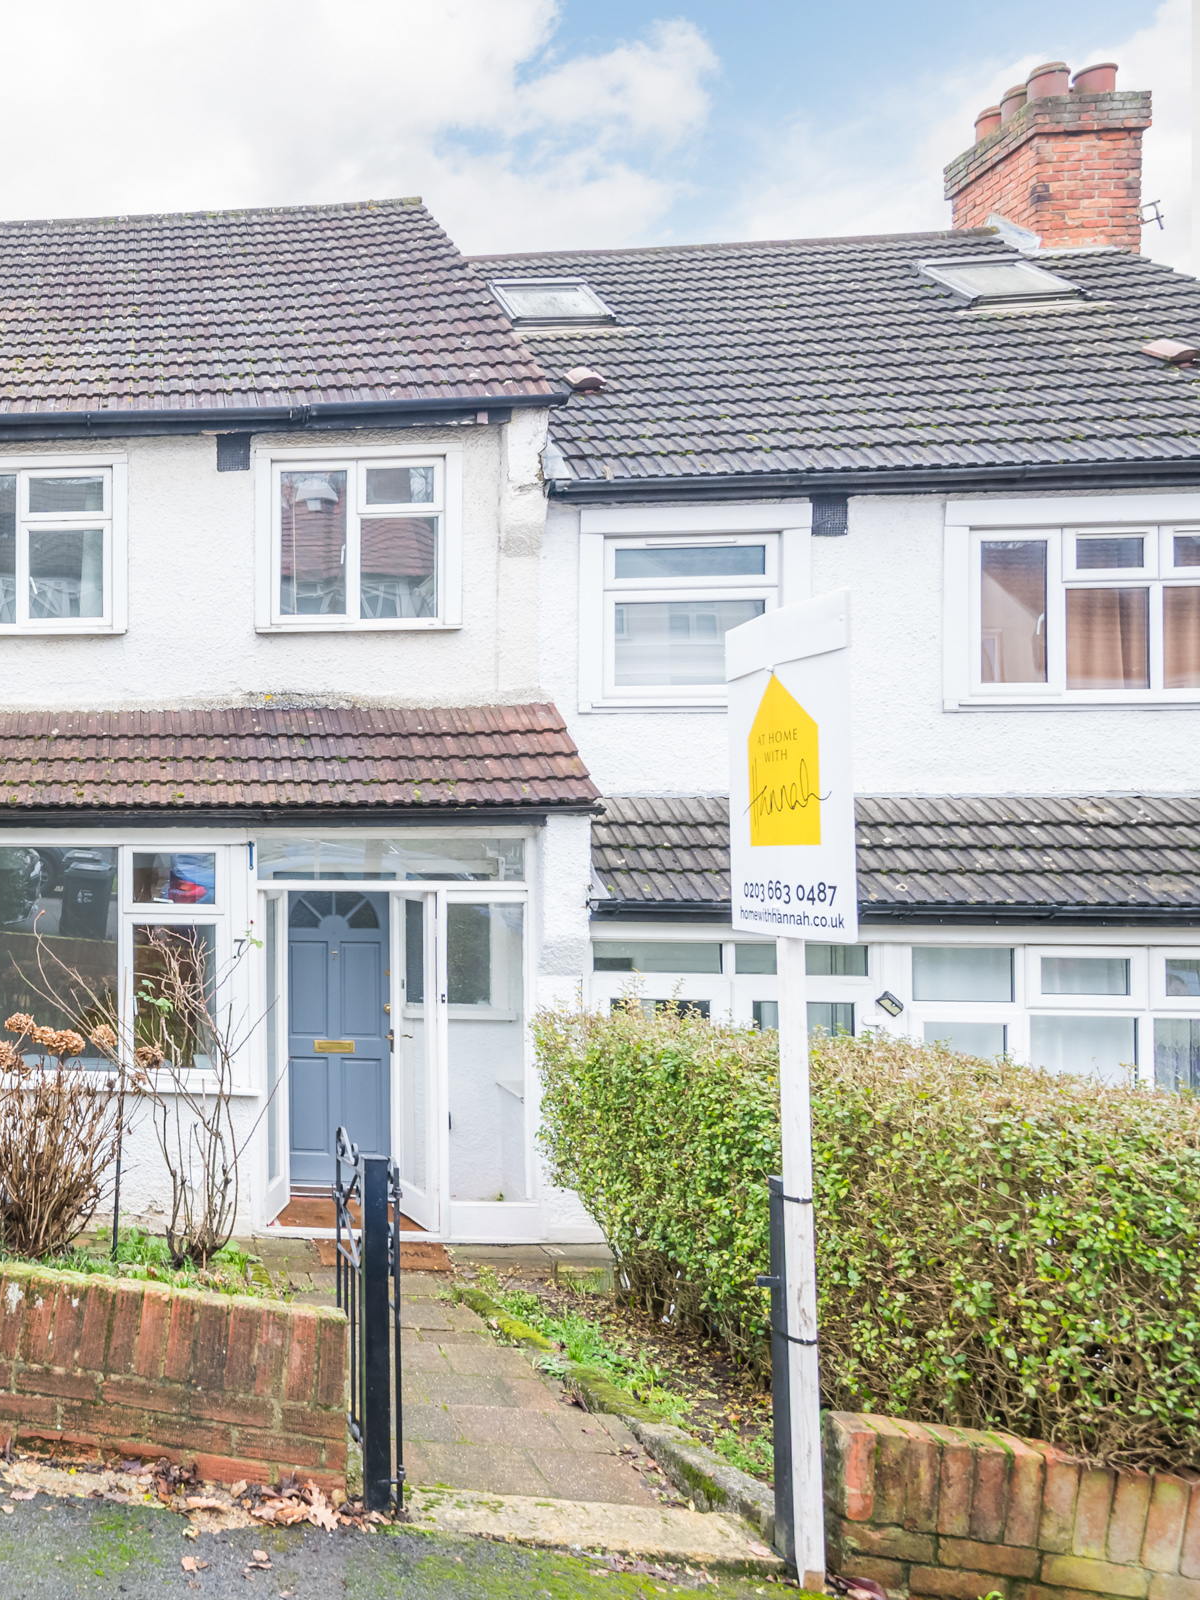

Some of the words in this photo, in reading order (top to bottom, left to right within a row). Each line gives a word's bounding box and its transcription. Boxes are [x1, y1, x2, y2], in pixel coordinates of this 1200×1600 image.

[757, 734, 766, 746] AT
[768, 728, 798, 745] HOME
[763, 748, 788, 763] WITH
[743, 757, 832, 837] Hannah
[743, 882, 765, 903] 0203
[767, 880, 791, 905] 663
[796, 882, 837, 907] 0487
[740, 906, 845, 929] homewithhannah.co.uk
[233, 938, 247, 957] 7
